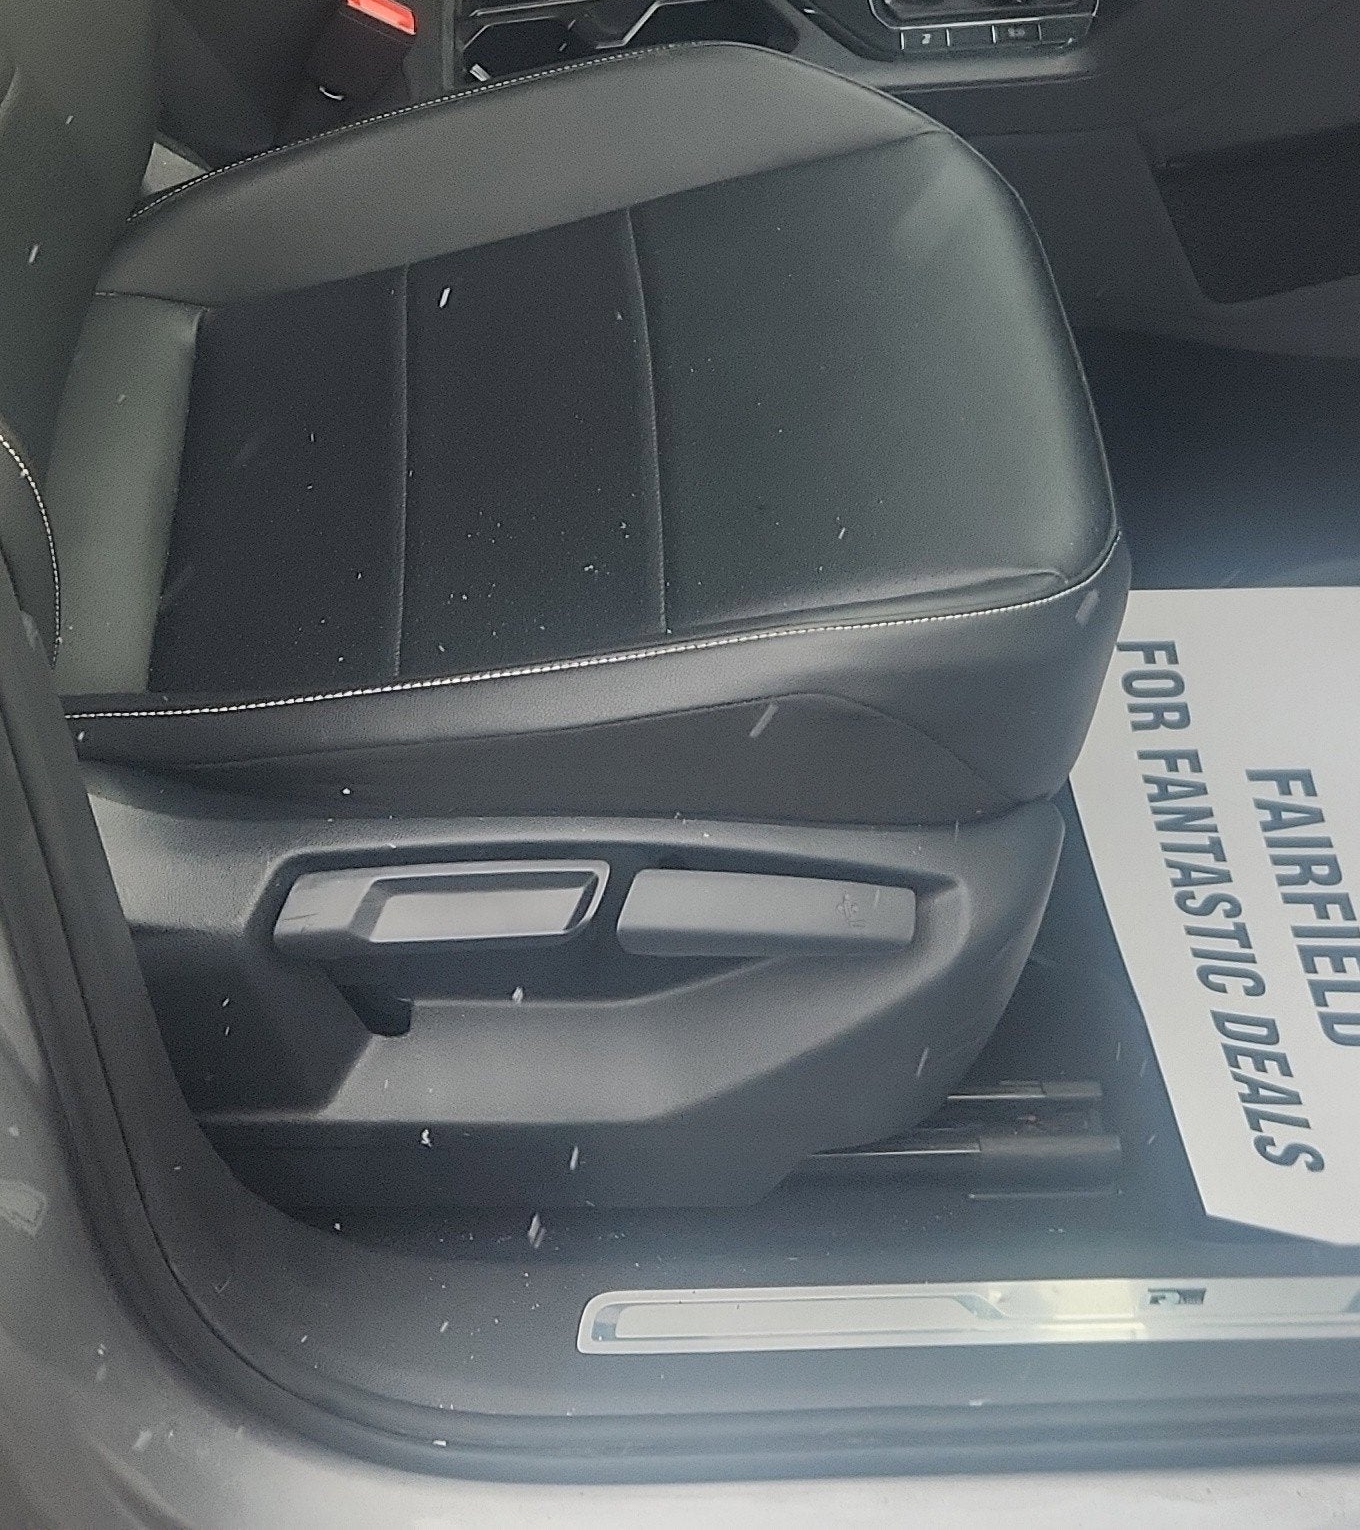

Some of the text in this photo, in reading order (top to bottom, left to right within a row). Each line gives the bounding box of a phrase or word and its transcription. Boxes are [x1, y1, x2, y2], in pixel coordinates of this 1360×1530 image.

[1116, 640, 1325, 1173] FOR FANTASTIC DEALS
